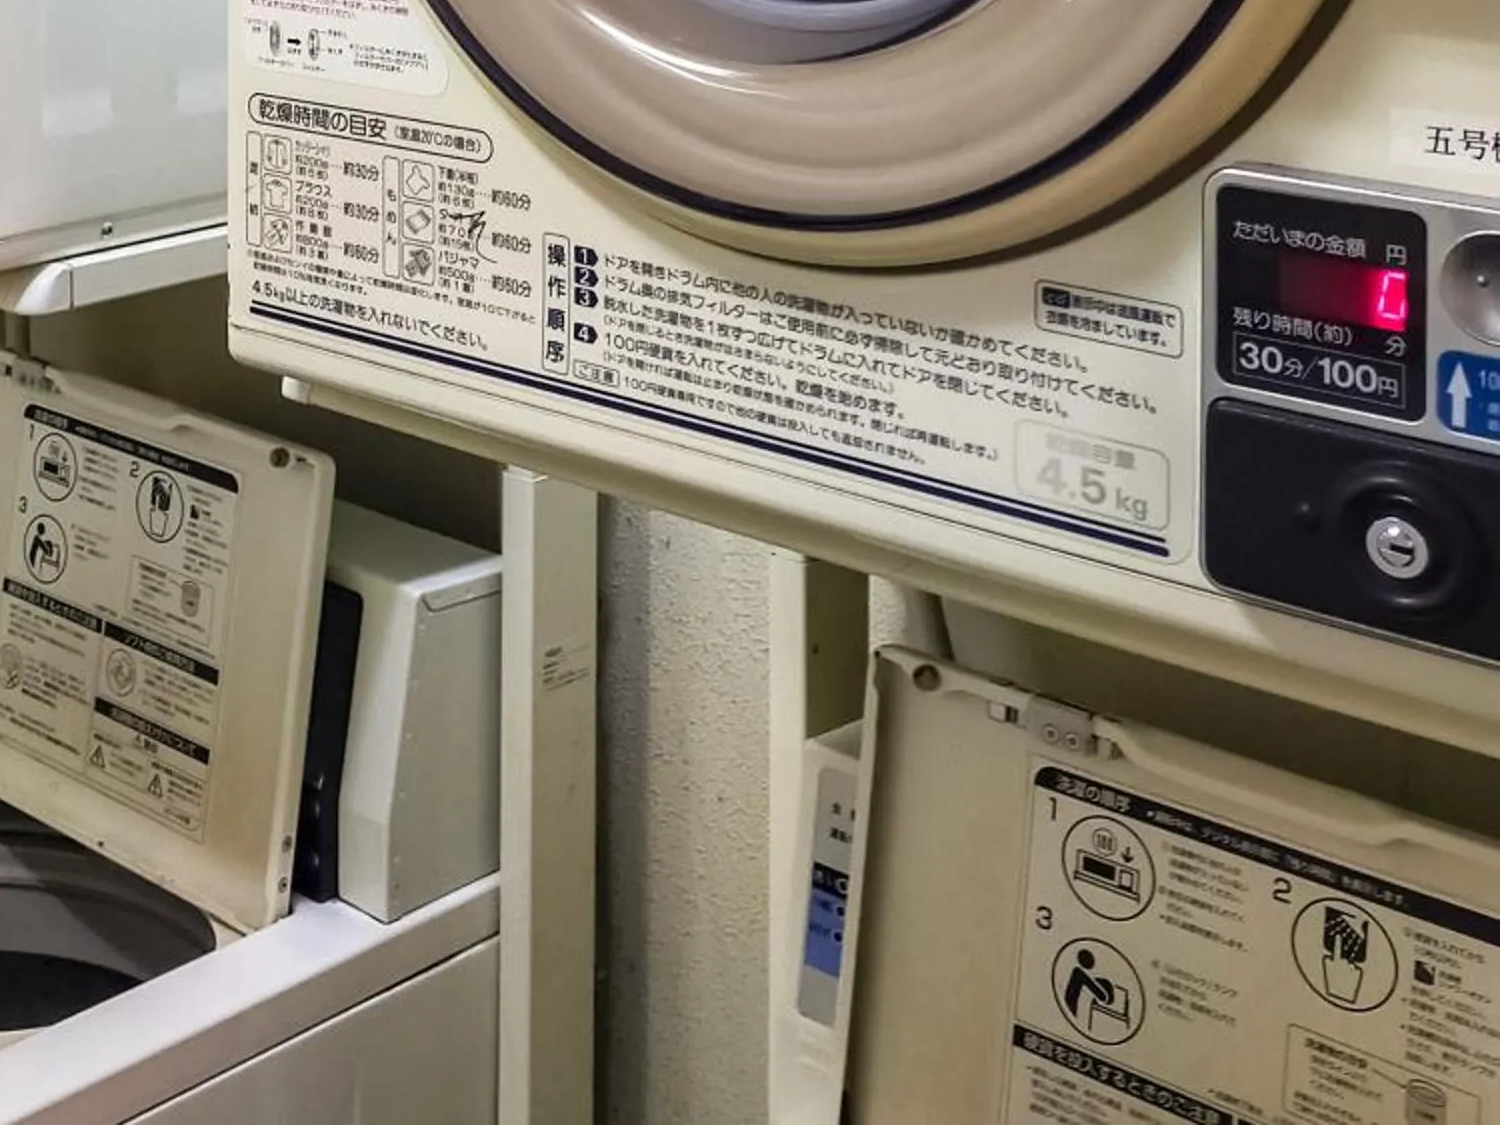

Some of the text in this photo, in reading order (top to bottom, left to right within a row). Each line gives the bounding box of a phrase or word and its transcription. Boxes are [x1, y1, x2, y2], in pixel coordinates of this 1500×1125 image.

[259, 98, 388, 141] 乾燥時間の目安
[1424, 125, 1500, 161] 五号
[438, 250, 480, 269] パジャマ
[1232, 220, 1408, 266] ただいまの金額 円
[545, 243, 567, 364] 操作順序
[1232, 305, 1408, 357] 残り時間(約) 分
[1238, 341, 1399, 399] 30分/100円
[129, 461, 141, 478] 2
[18, 496, 28, 514] 3
[1036, 457, 1148, 522] 4.5 kg
[1048, 796, 1058, 821] 1
[1272, 876, 1293, 904] 2
[1034, 905, 1054, 931] 3
